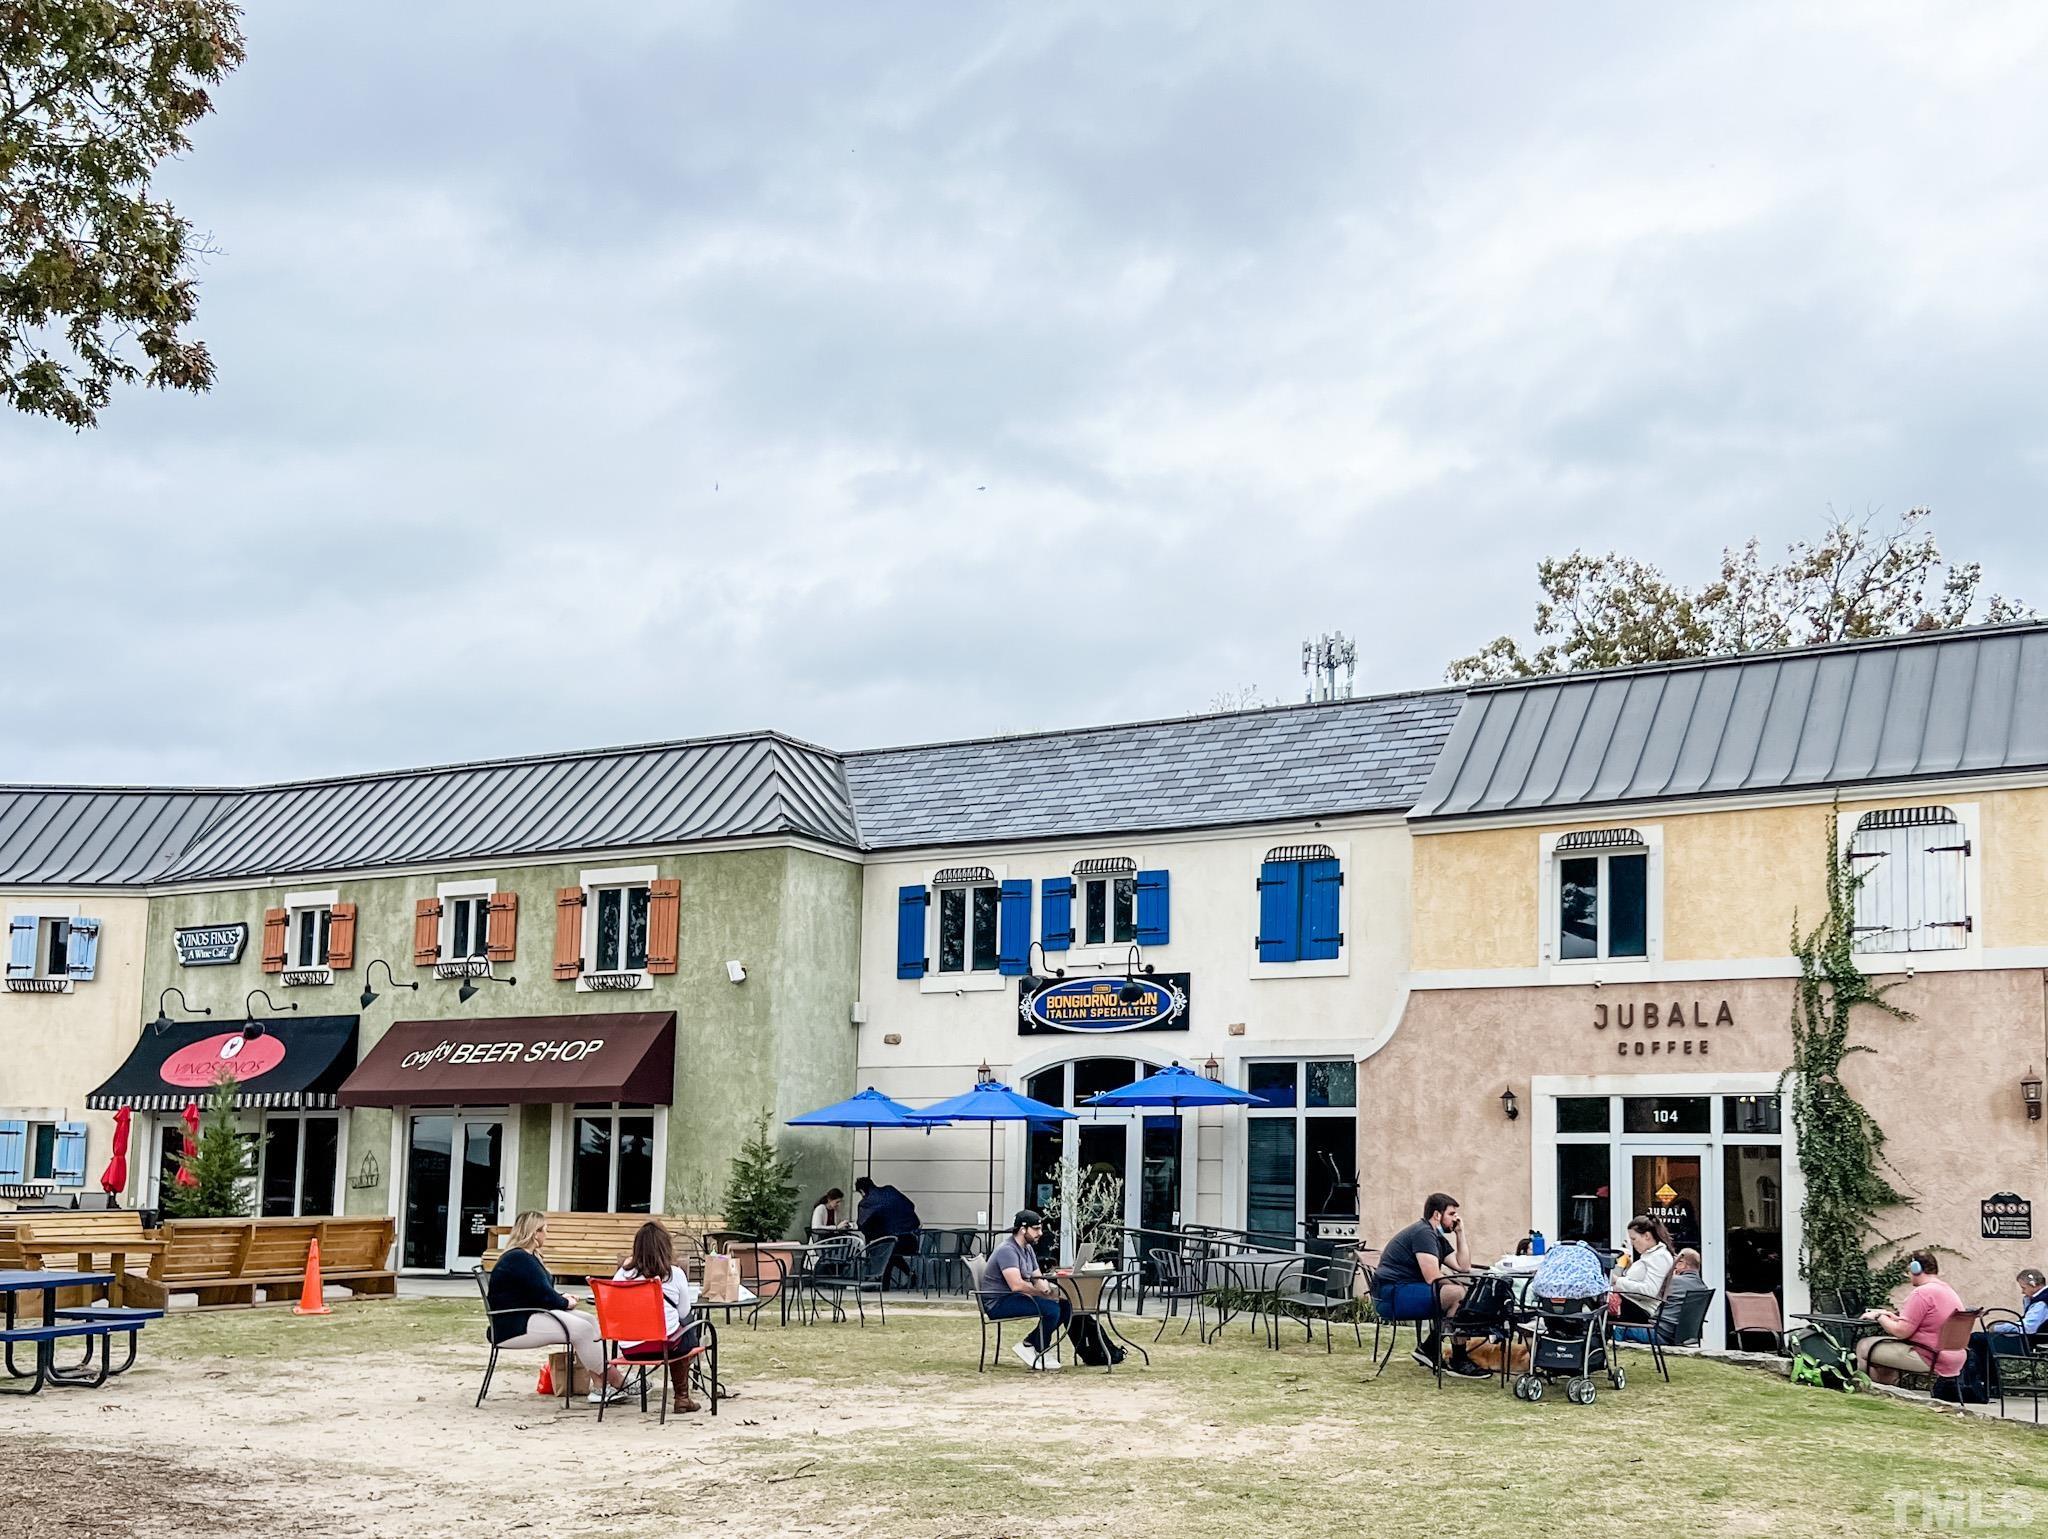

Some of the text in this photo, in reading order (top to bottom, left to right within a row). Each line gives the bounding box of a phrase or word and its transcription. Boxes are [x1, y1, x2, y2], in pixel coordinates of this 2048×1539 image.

[182, 930, 236, 947] VINOS FINOS
[188, 949, 194, 959] A
[195, 949, 211, 958] Wine
[1046, 993, 1118, 1009] BONGIORNO
[1046, 1006, 1158, 1019] ITALIAN SPECIALTIES
[1593, 1000, 1734, 1030] JUBALA
[401, 1039, 604, 1071] Crafty BEER SHOP
[1617, 1040, 1709, 1056] COFFEE
[174, 1060, 220, 1075] VINOS
[1653, 1110, 1678, 1123] 104
[1646, 1207, 1687, 1217] JUBALA
[1983, 1216, 1999, 1234] NO
